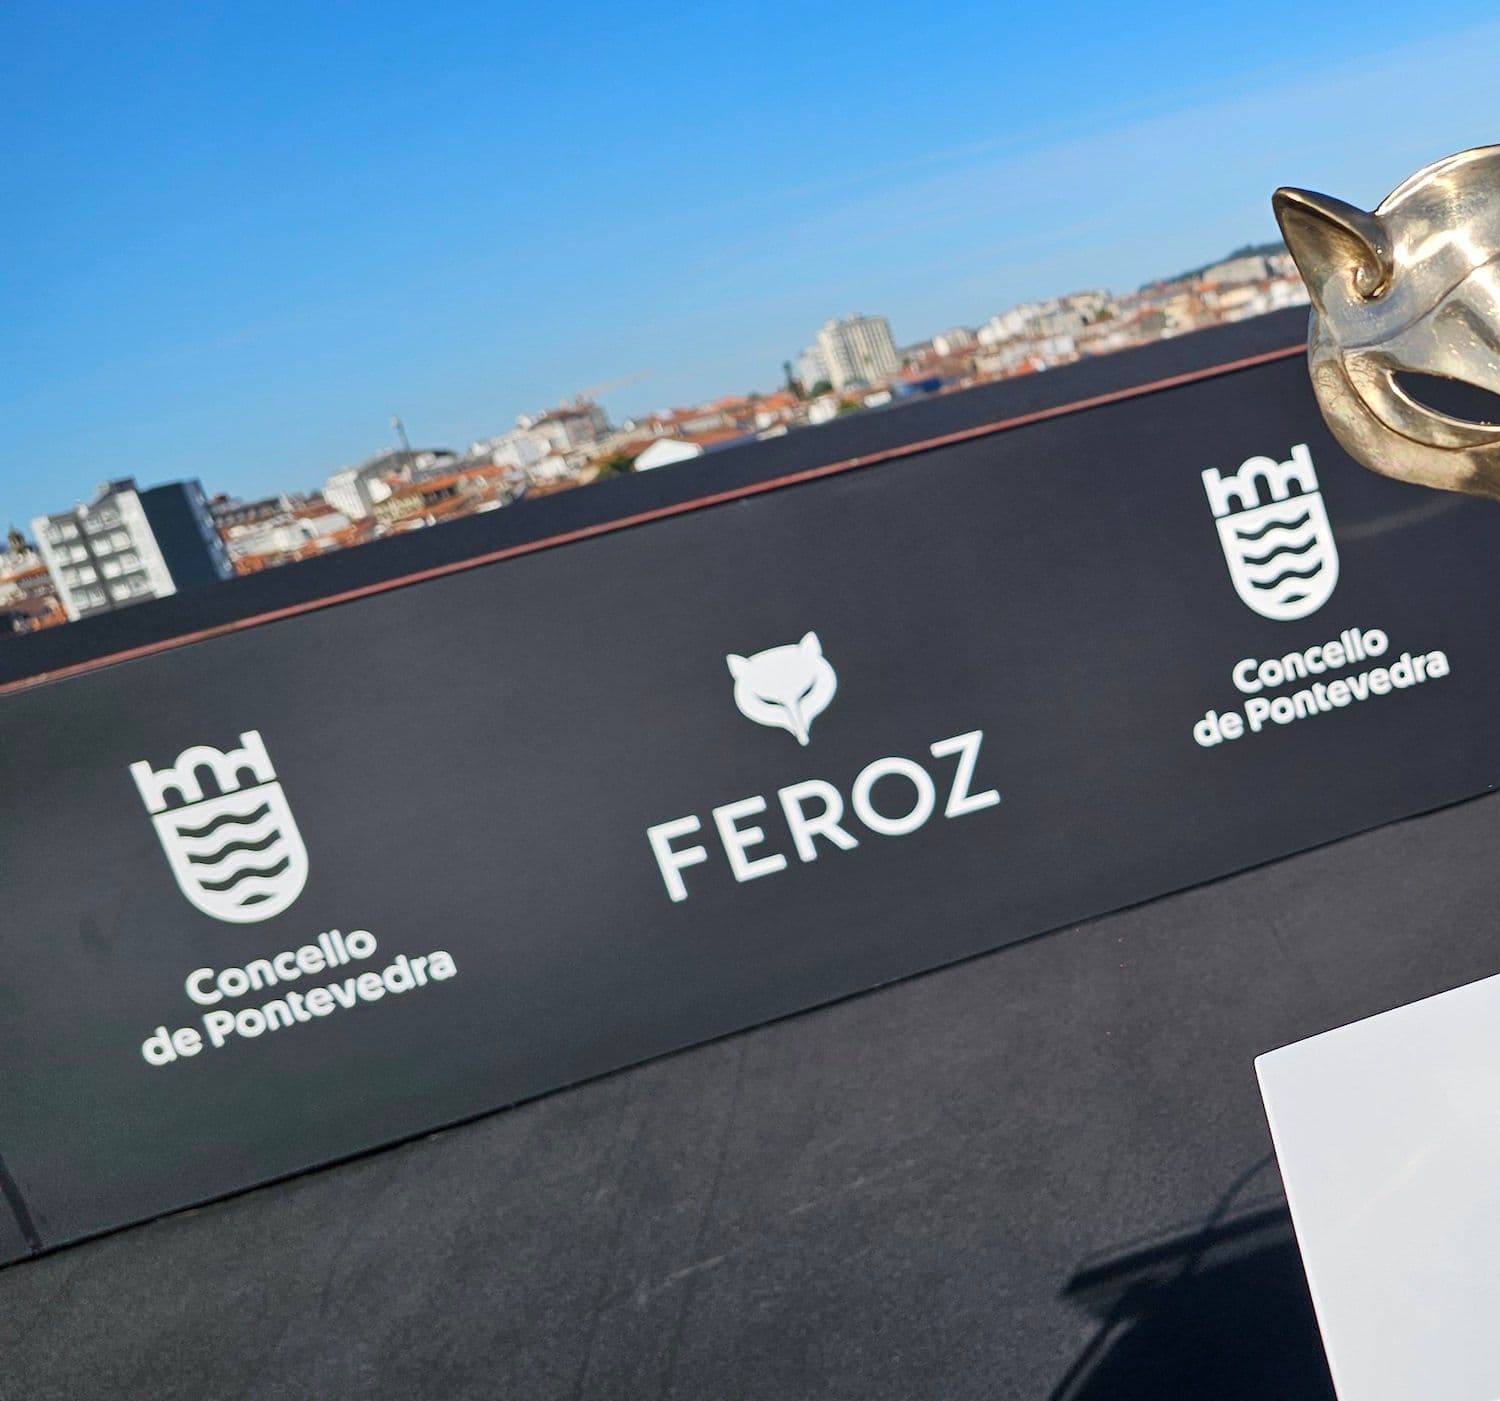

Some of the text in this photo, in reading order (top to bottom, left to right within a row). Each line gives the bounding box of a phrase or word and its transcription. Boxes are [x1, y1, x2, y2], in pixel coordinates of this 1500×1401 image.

[1193, 649, 1451, 749] de Pontevedra
[1232, 626, 1390, 695] Concello
[646, 728, 1002, 904] FEROZ
[141, 949, 459, 1067] de Pontevedra
[184, 927, 379, 1007] Concello
